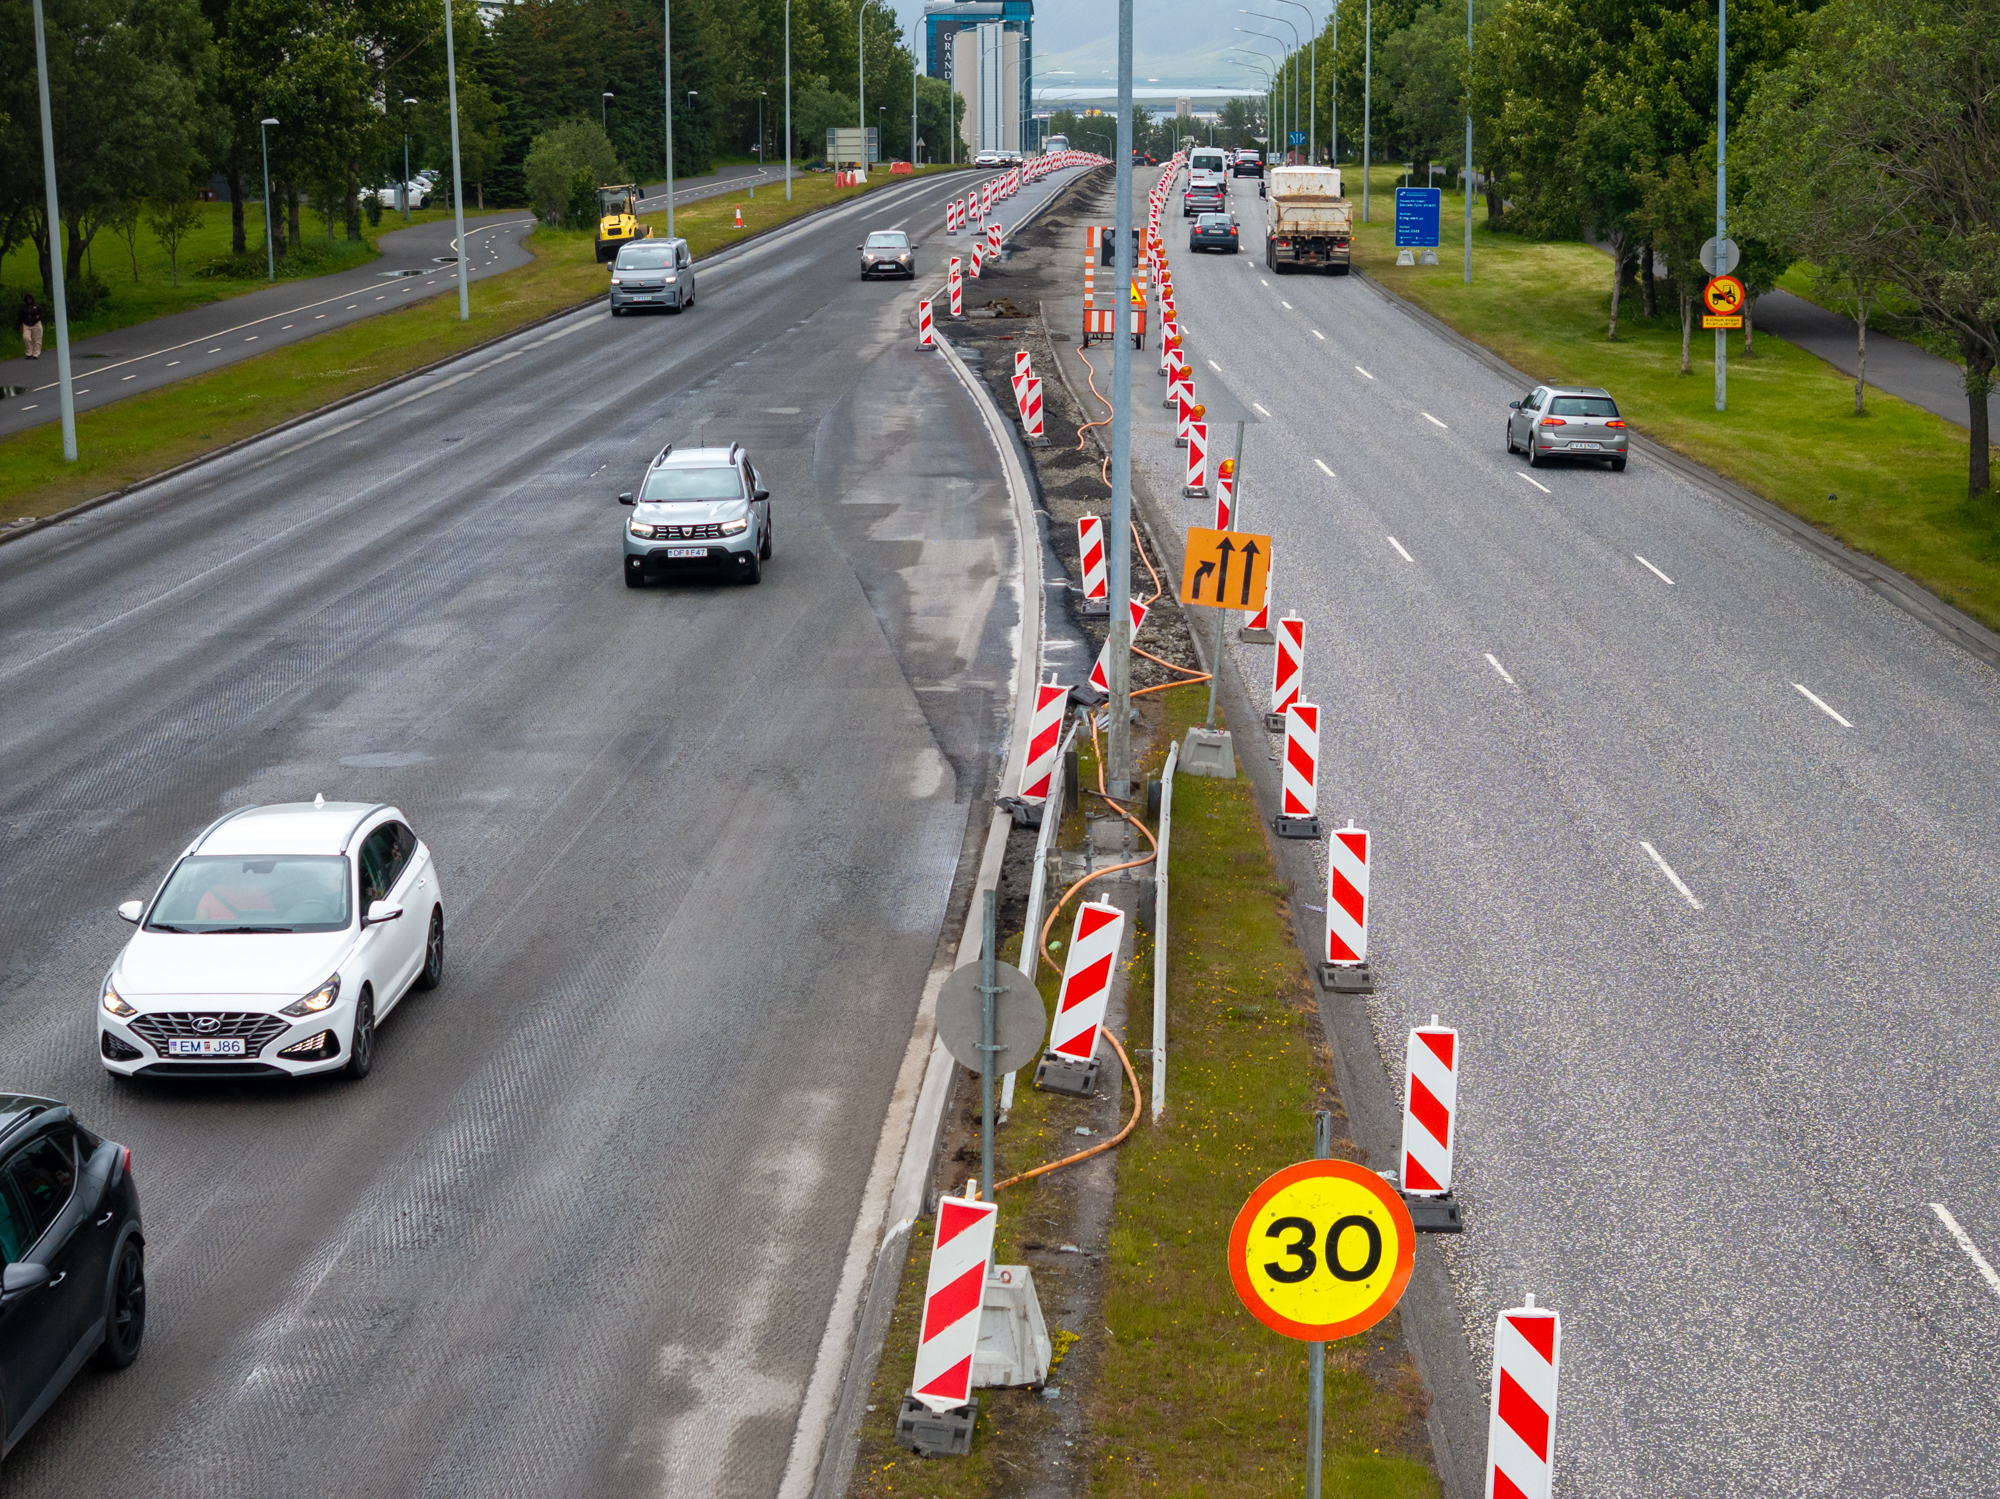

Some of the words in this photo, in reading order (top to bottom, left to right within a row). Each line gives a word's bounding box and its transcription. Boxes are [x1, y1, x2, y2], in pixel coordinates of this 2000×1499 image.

[944, 32, 952, 79] GRAND
[180, 1041, 201, 1052] EM
[213, 1041, 240, 1052] J86
[1263, 1215, 1382, 1284] 30
